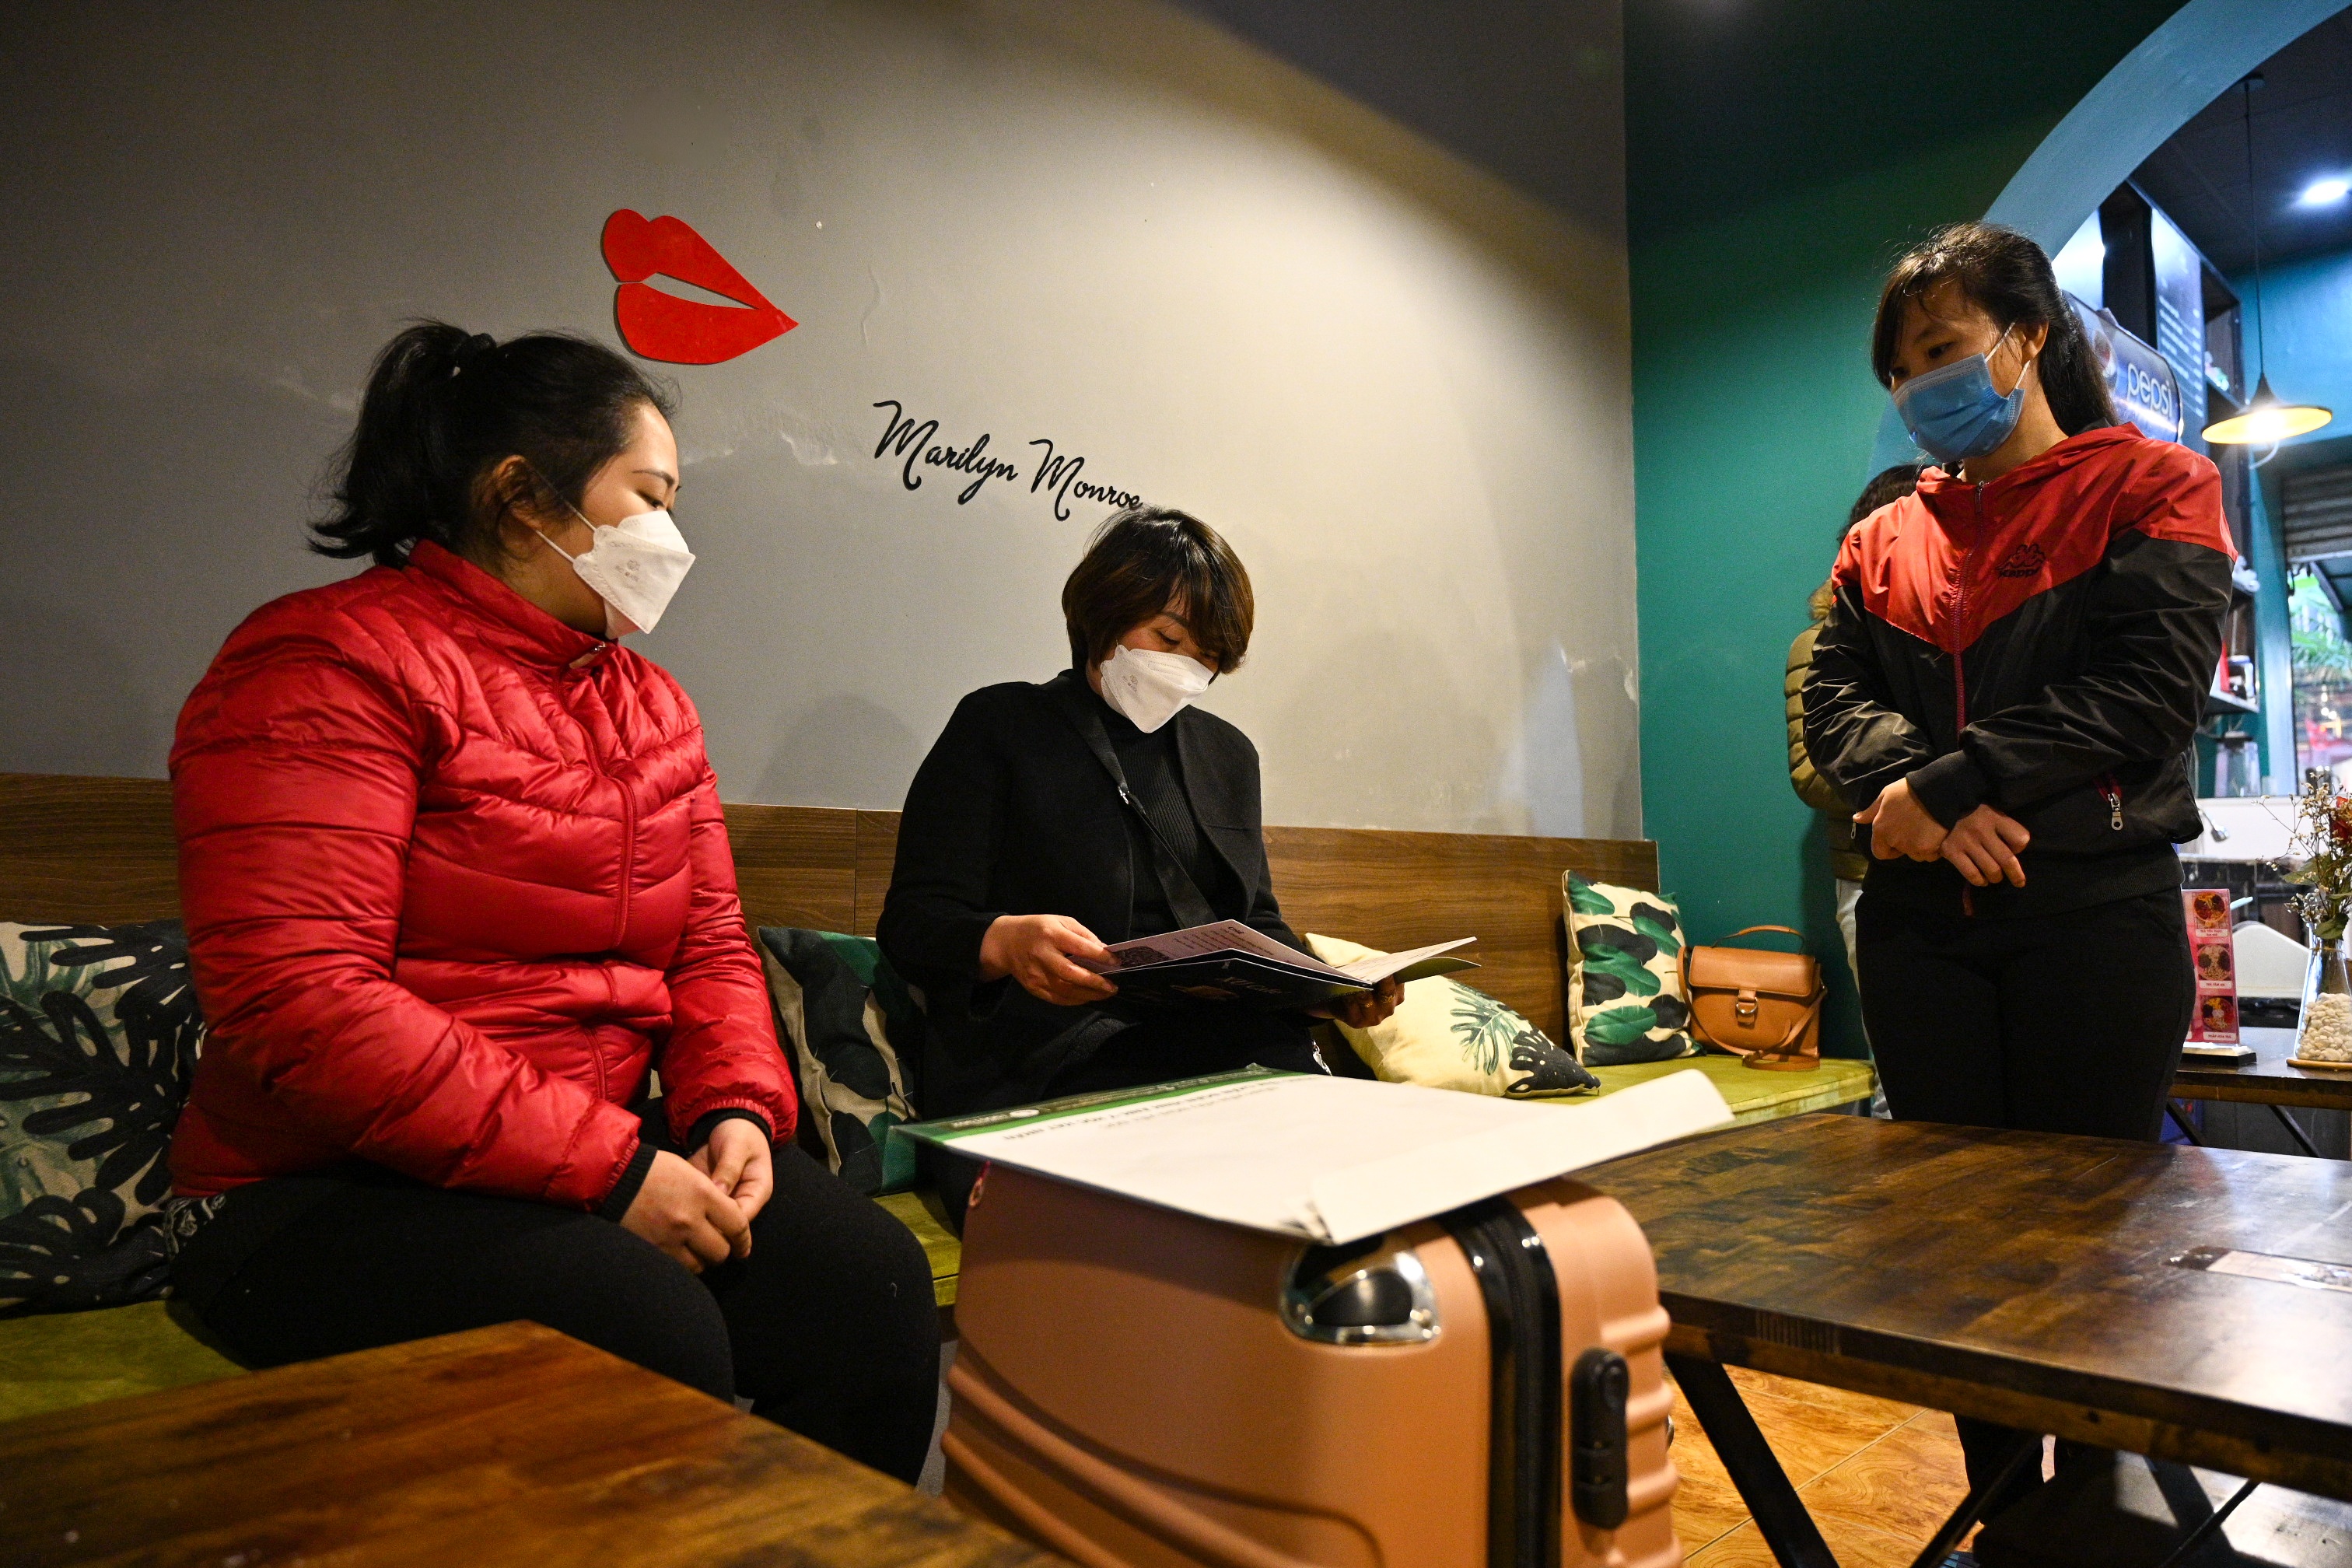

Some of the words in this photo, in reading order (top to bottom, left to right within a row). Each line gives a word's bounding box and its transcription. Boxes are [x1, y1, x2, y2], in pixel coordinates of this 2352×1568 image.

[2126, 362, 2172, 418] pepsi
[873, 400, 1018, 505] Marilyn
[1029, 439, 1143, 521] Monroe
